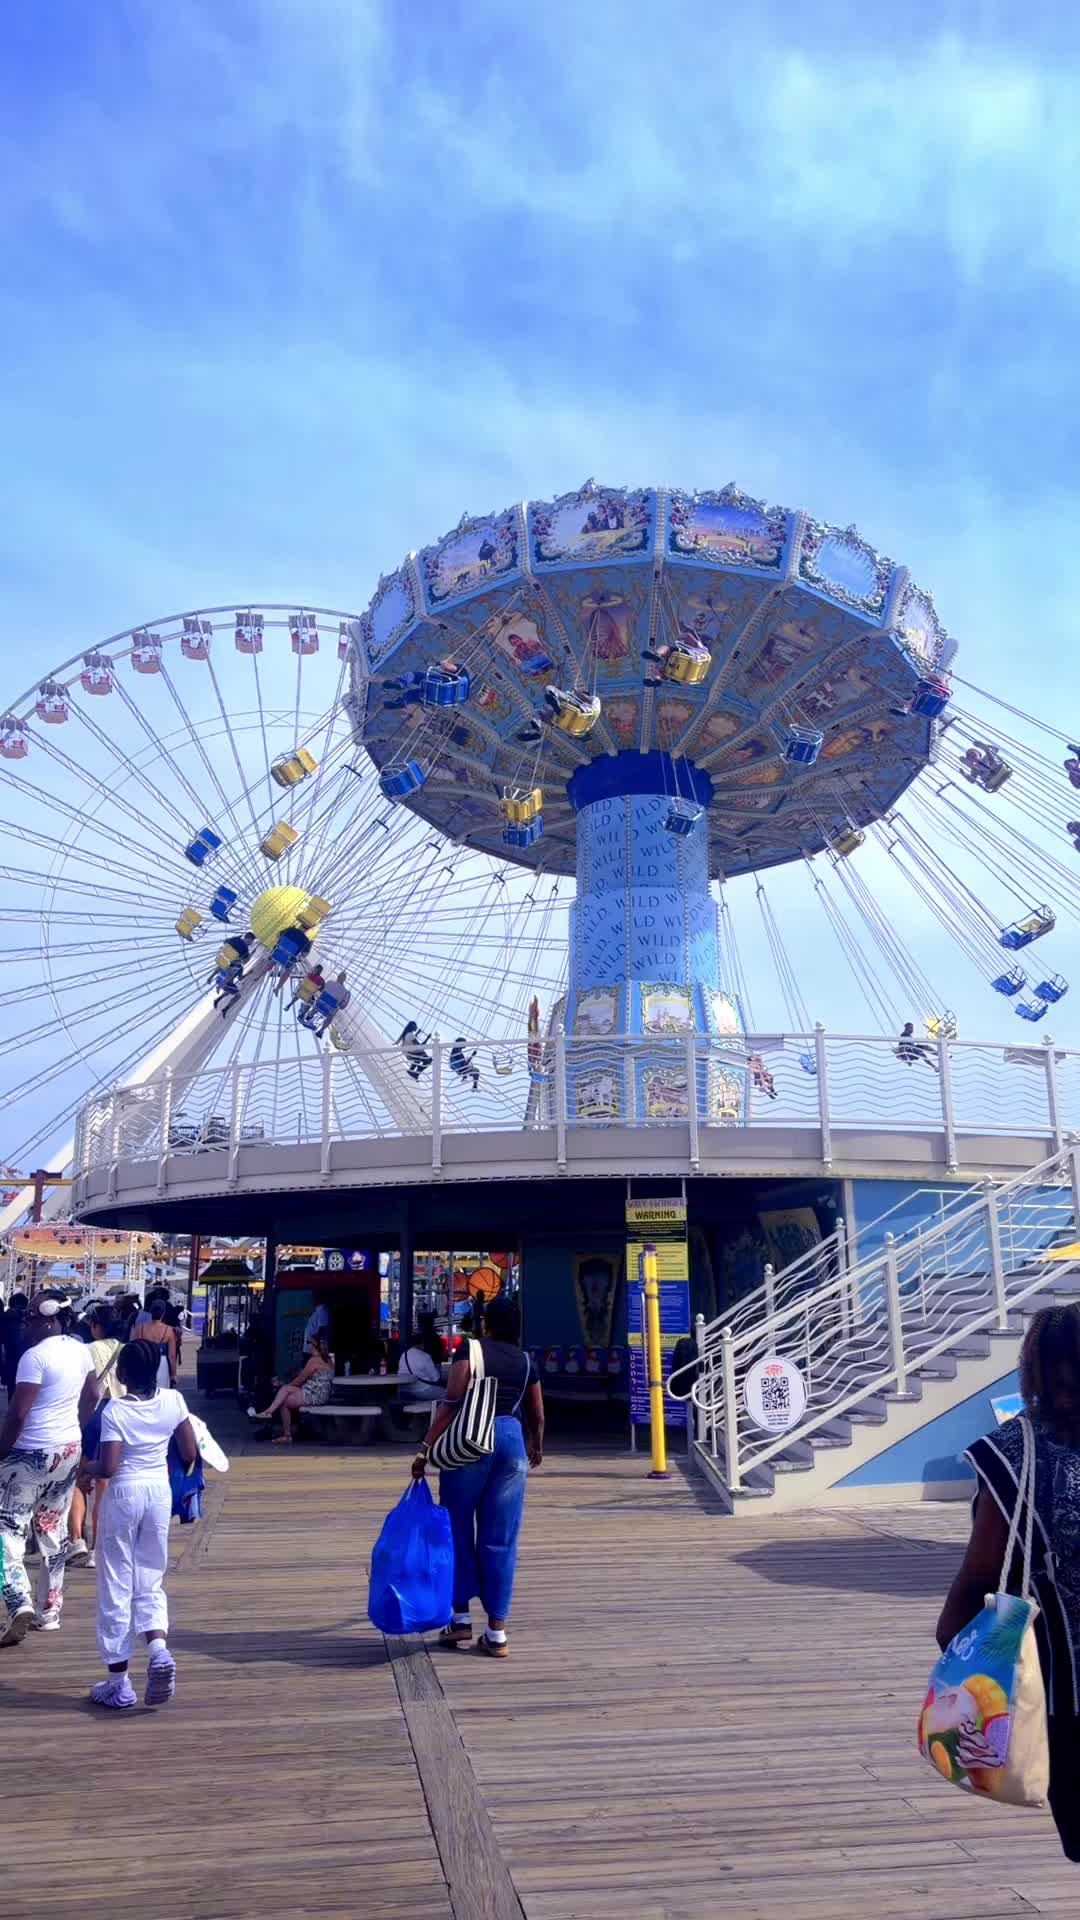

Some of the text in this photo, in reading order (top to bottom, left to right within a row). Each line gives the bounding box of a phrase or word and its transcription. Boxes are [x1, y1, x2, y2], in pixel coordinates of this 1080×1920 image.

[641, 837, 678, 857] WILD
[611, 915, 655, 935] WLD
[637, 935, 681, 947] WILD
[632, 953, 676, 972] WILD
[634, 1210, 676, 1220] WARNING
